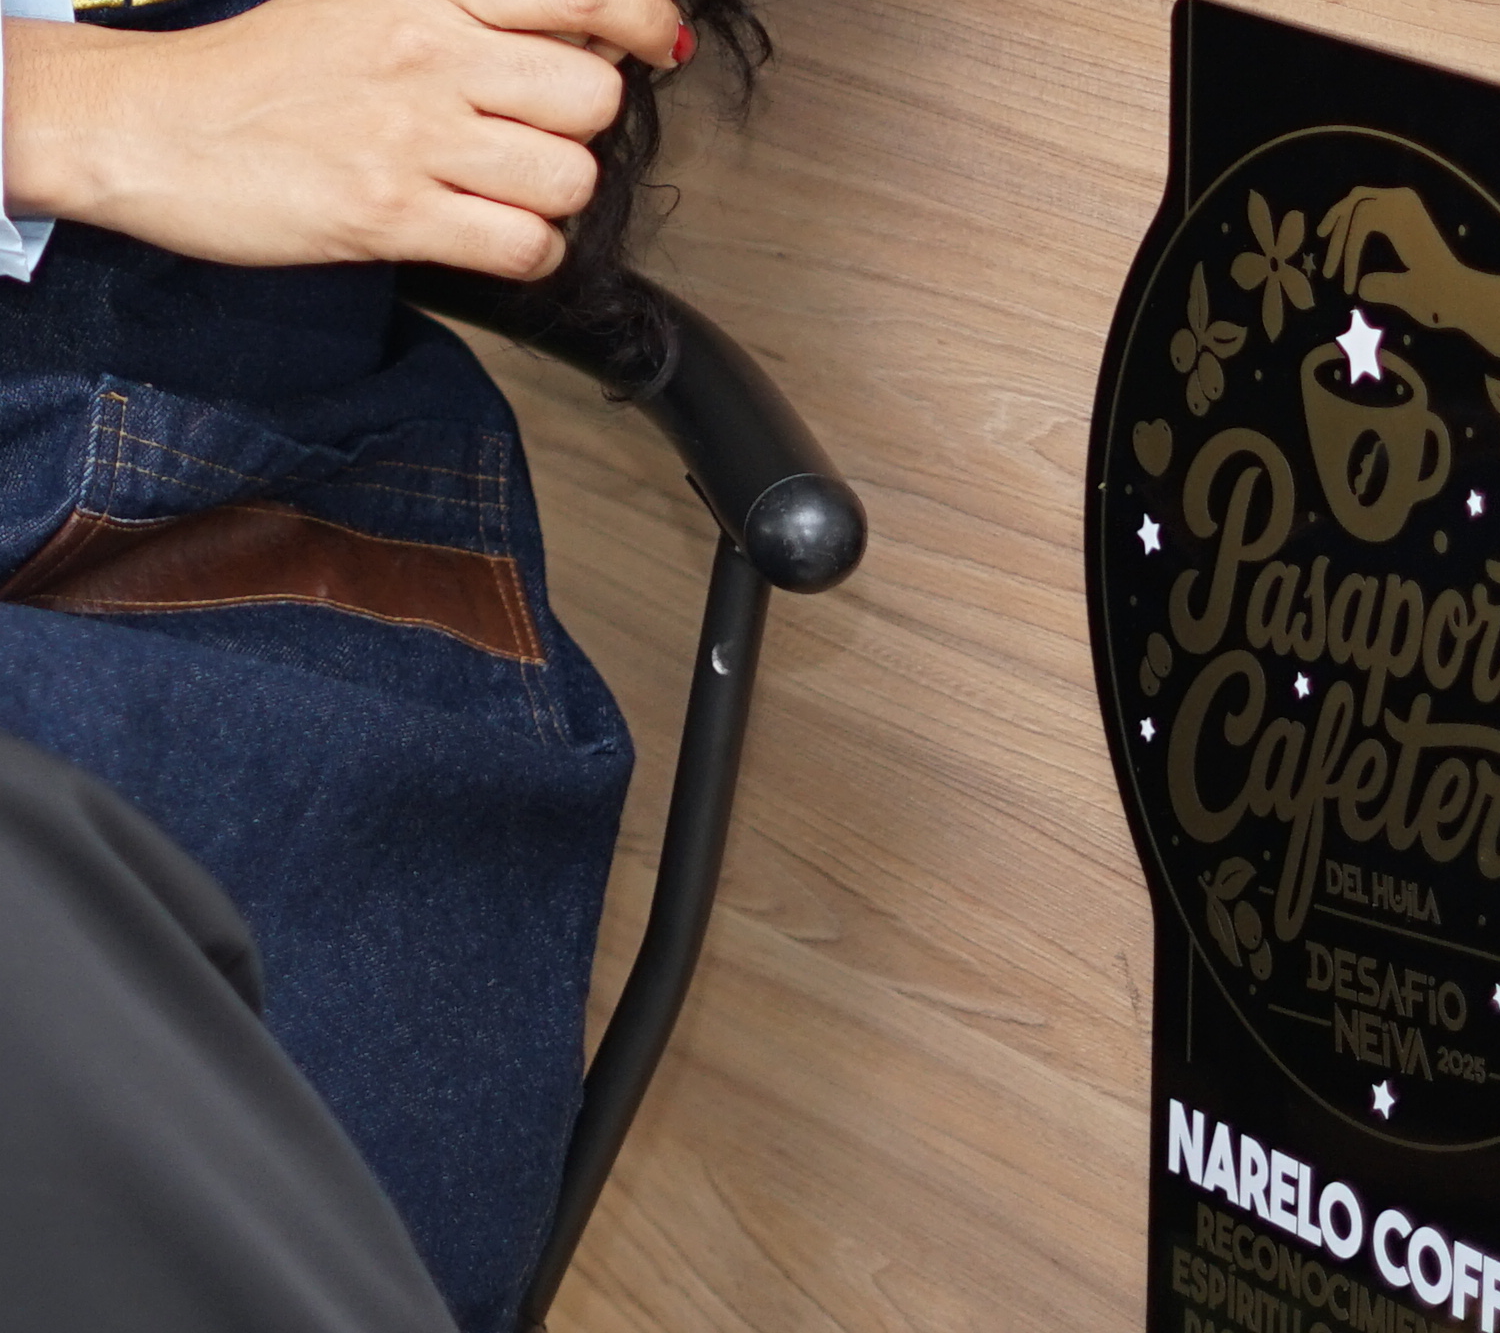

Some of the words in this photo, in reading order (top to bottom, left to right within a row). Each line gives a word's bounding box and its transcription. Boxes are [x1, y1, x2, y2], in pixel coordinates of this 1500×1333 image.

[1325, 858, 1371, 905] DEL
[1436, 1044, 1487, 1084] 2025
[1168, 1097, 1363, 1260] NARELO
